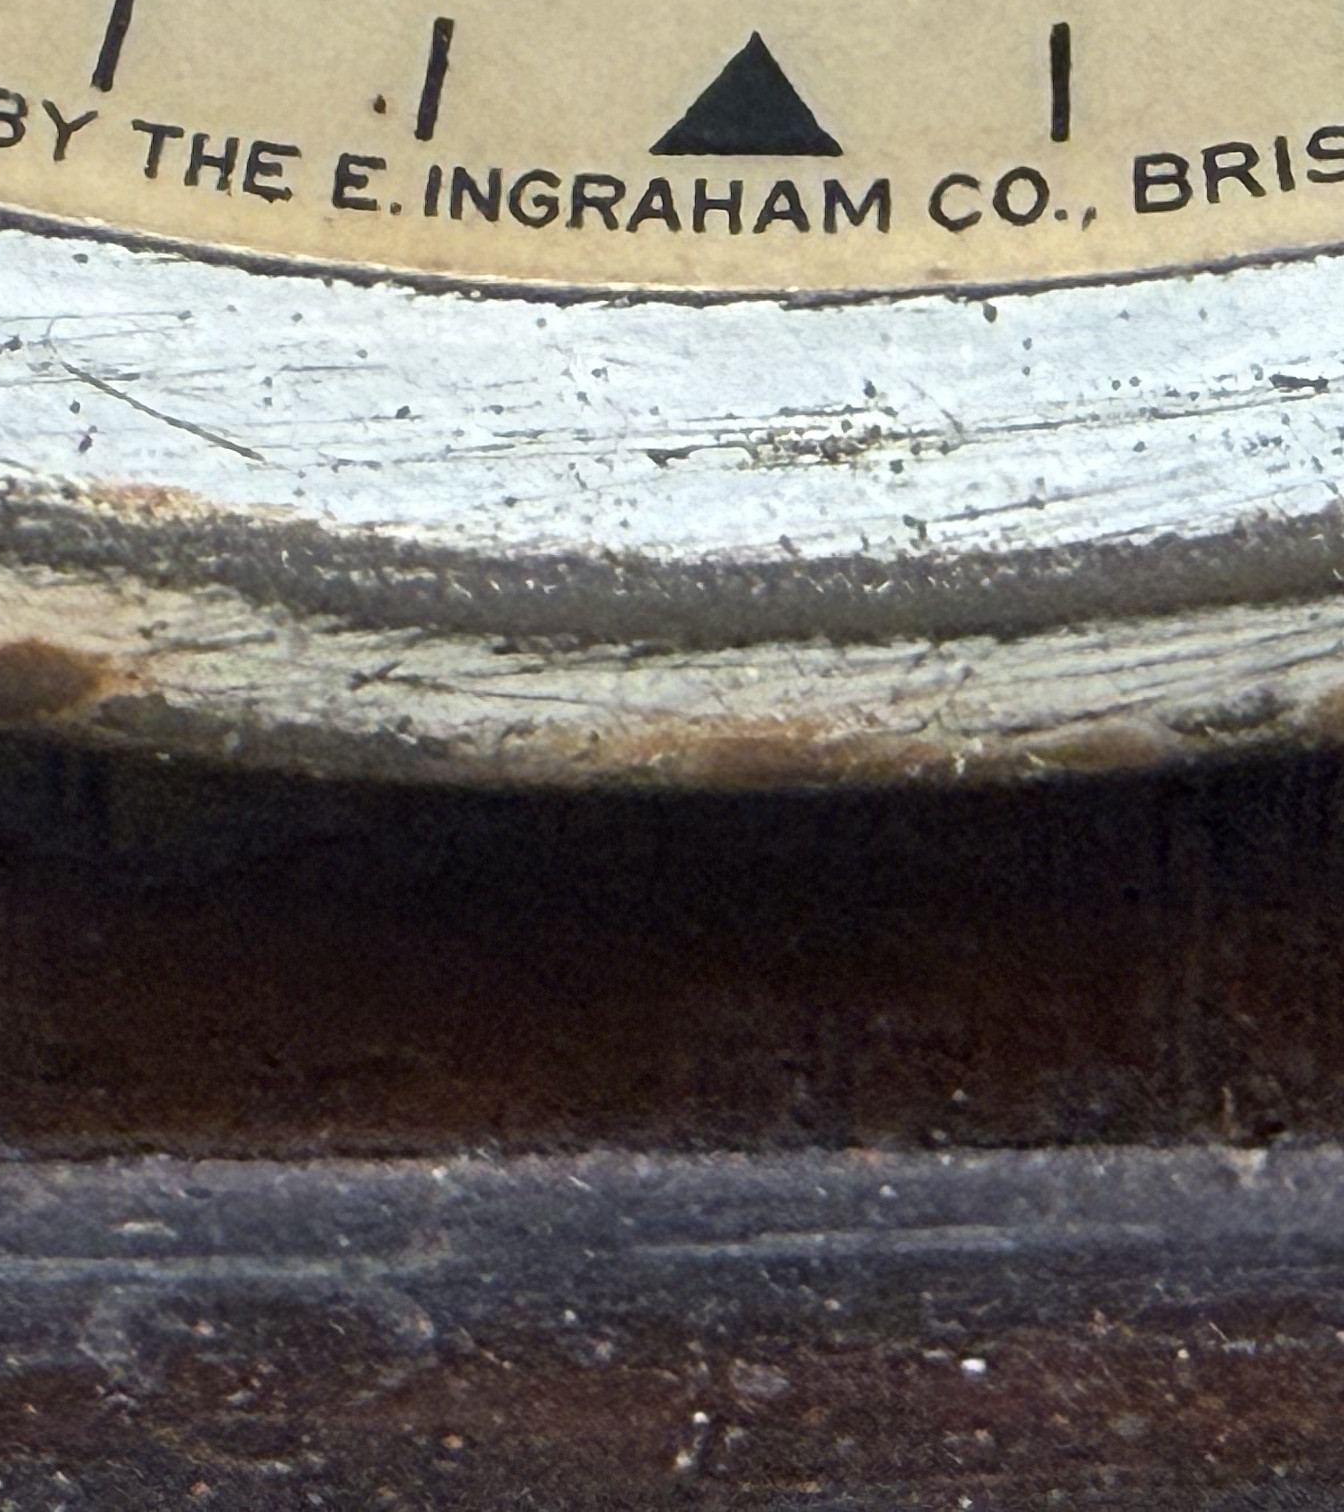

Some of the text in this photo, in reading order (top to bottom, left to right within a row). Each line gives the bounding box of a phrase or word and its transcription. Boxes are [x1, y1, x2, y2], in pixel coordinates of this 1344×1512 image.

[130, 118, 303, 205] THE
[330, 151, 403, 218] E.
[422, 163, 893, 236] INGRAHAM
[927, 165, 1098, 234] CO.,
